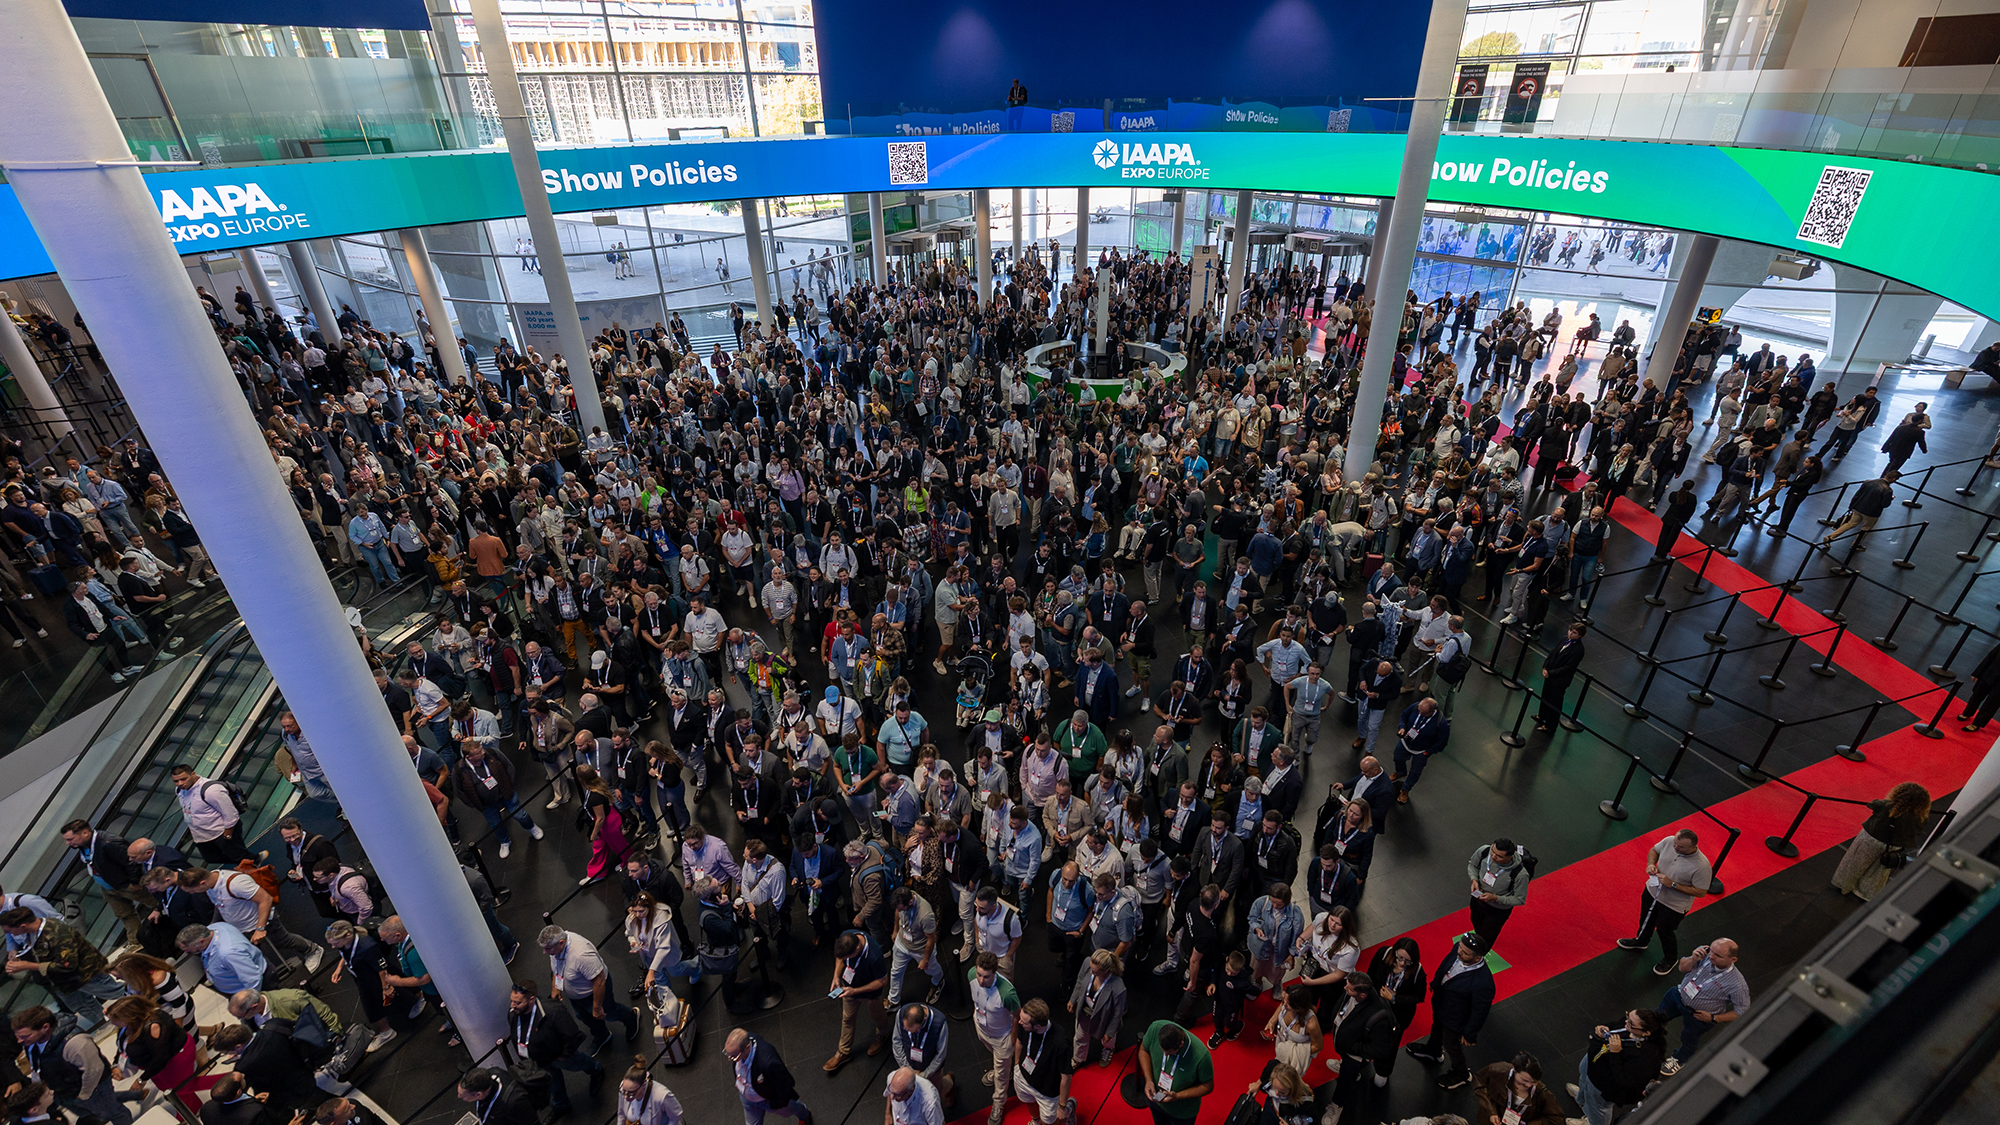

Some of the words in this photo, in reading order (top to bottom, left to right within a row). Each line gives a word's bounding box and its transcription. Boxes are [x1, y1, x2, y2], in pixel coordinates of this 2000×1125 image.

[540, 168, 623, 194] Show
[629, 159, 738, 188] Policies
[1121, 167, 1156, 179] EXPO
[1157, 167, 1211, 180] EUROPE
[1488, 157, 1610, 194] Policies
[221, 212, 311, 237] EUROPE
